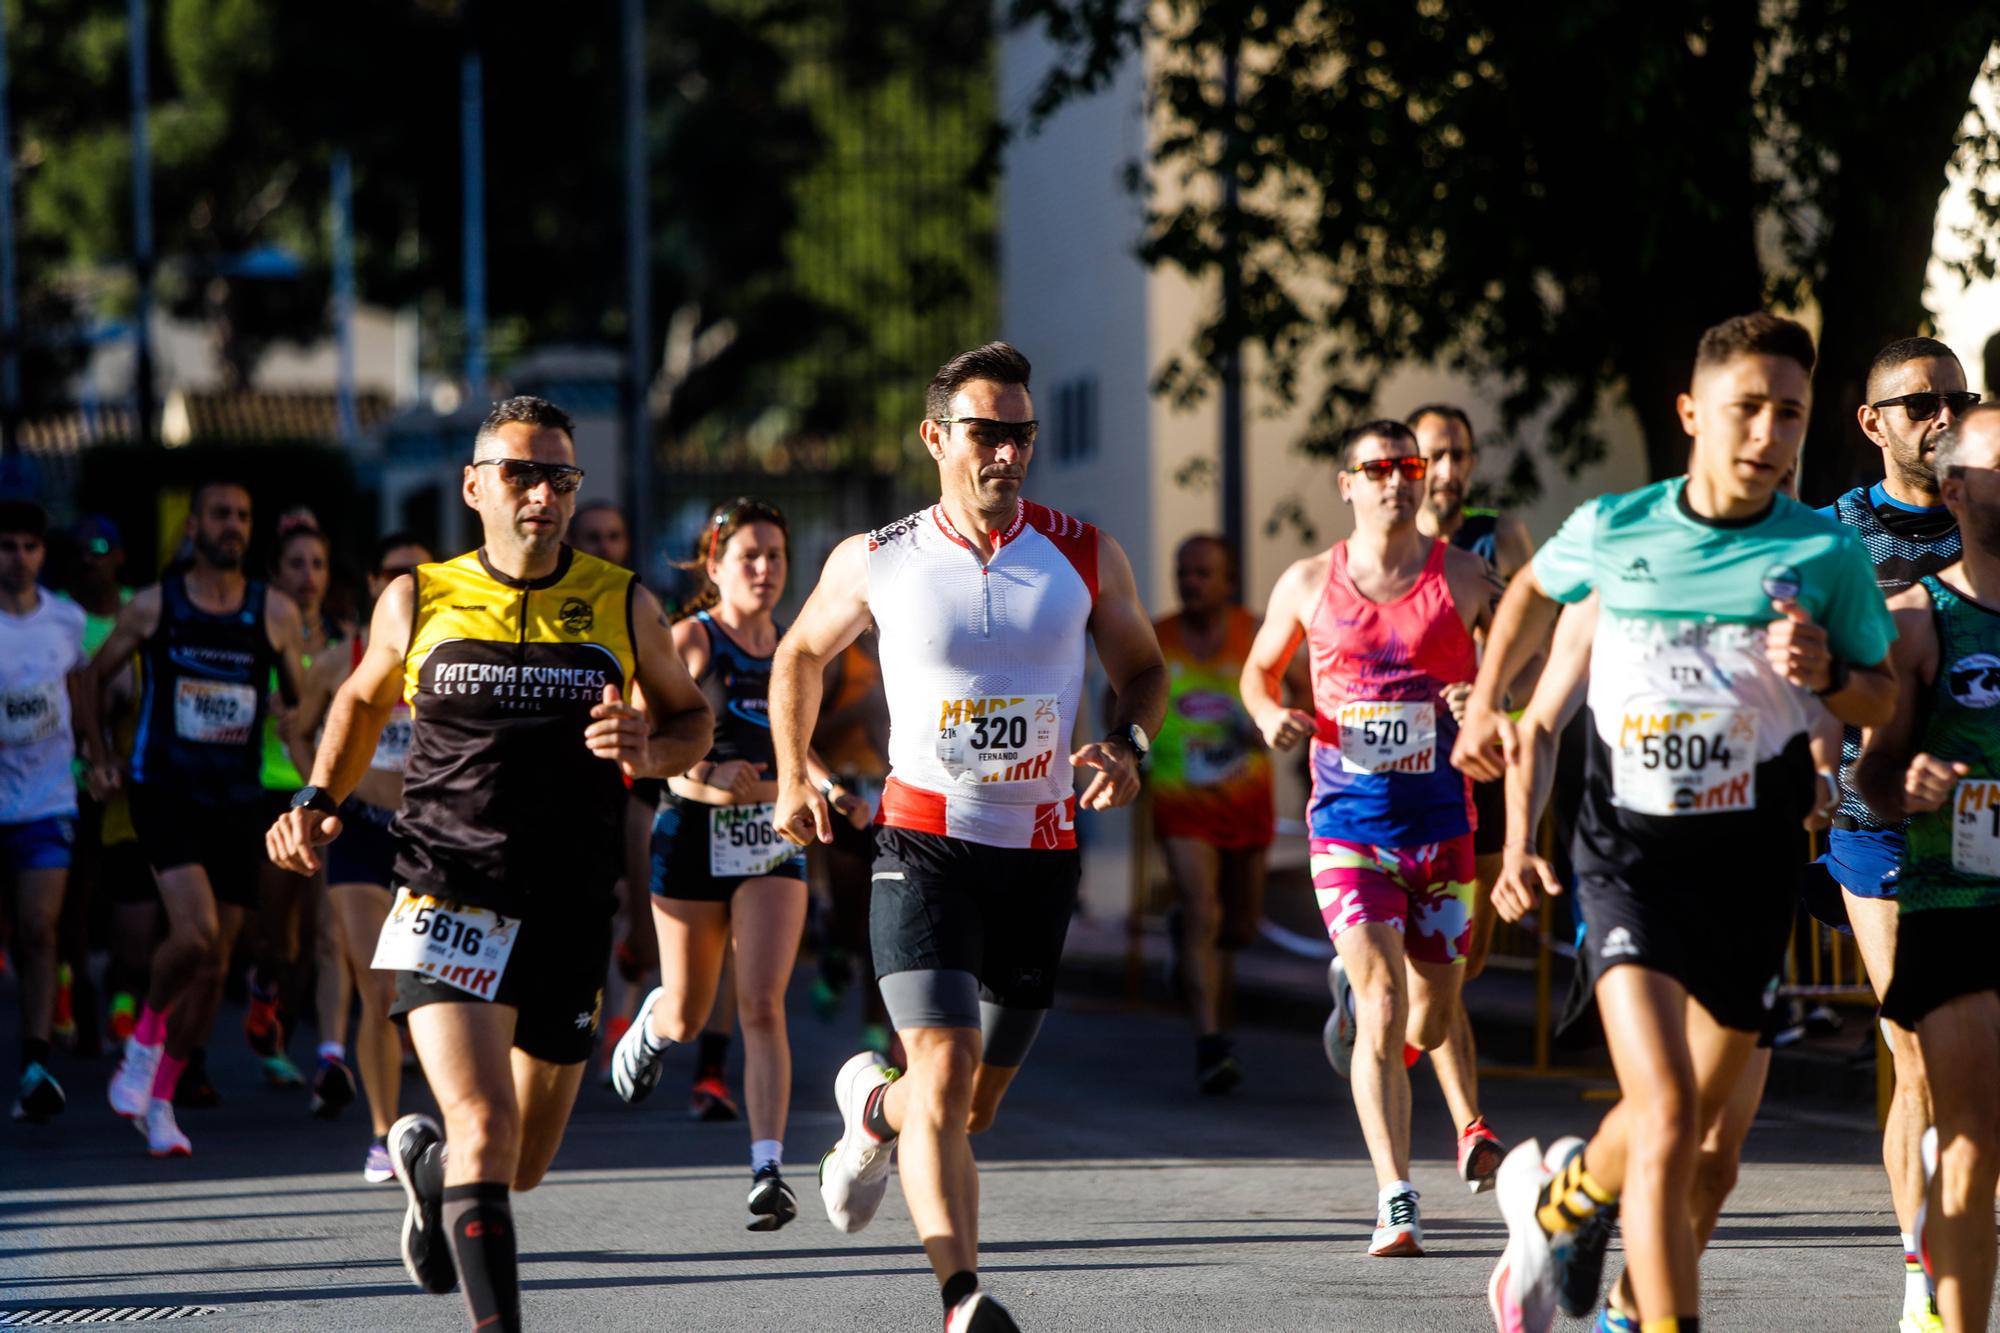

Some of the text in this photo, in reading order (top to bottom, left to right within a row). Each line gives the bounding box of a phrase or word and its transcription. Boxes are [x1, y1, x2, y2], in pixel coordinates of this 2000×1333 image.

[434, 662, 606, 688] PATERNA RUNNERS
[433, 682, 480, 695] CLUB
[500, 700, 542, 711] TRAIL
[970, 716, 1027, 749] 320
[1364, 720, 1407, 746] 570
[978, 752, 1018, 761] FERNANDO
[1642, 733, 1730, 771] 5804
[412, 907, 484, 957] 5616
